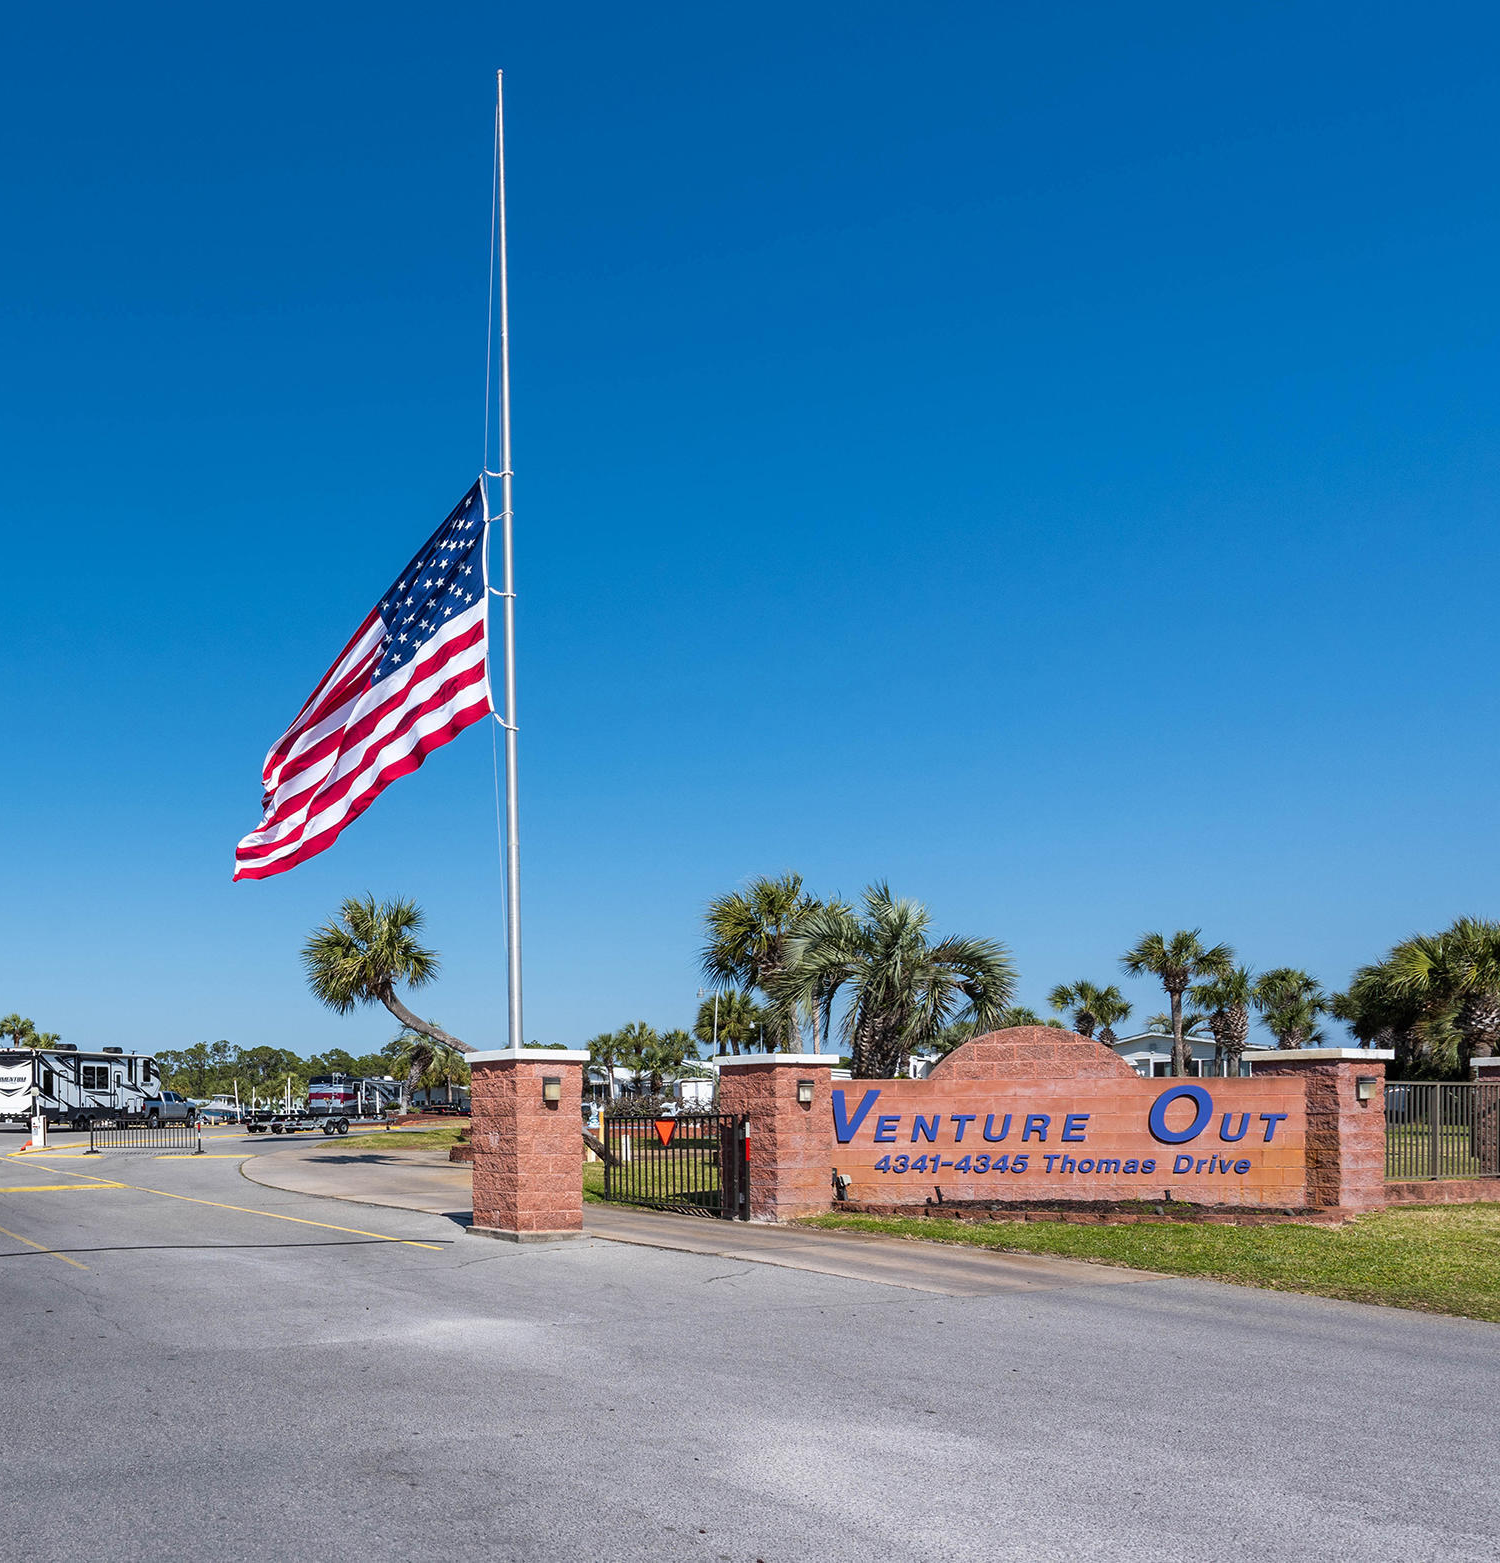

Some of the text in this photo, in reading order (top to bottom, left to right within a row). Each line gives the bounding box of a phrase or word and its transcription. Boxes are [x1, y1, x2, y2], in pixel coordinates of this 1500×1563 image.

[831, 1084, 1287, 1144] VENTURE OUT
[874, 1153, 1252, 1175] 4341-4345 Thomas Drive
